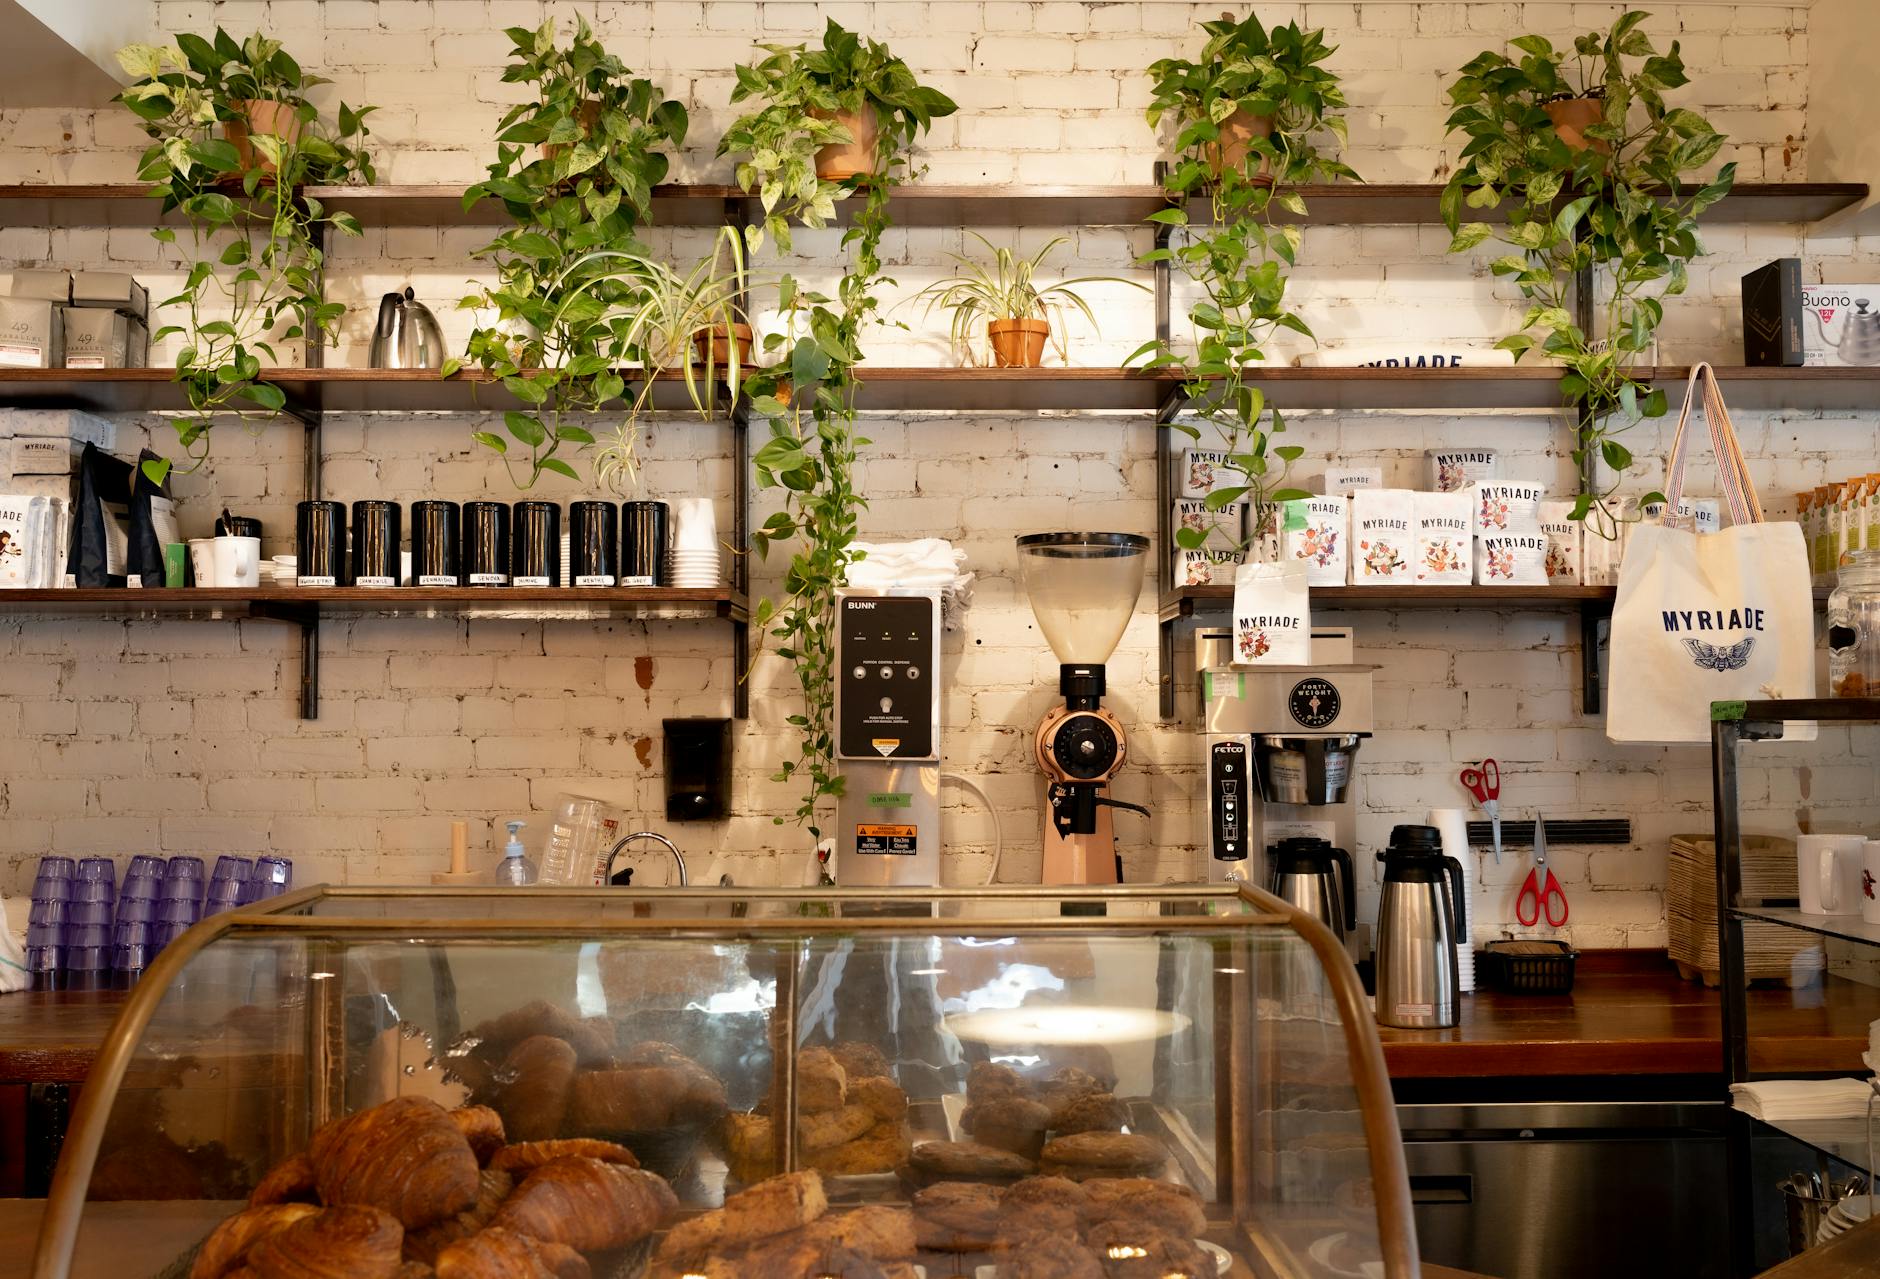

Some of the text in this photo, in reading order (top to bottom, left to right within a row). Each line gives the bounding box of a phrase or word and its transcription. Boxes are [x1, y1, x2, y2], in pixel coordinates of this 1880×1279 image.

[1801, 292, 1851, 306] Buono
[1437, 453, 1493, 465] MYRIADE
[1481, 487, 1540, 501] MYRIADE
[1363, 519, 1408, 531] MYRIADE
[1421, 518, 1467, 530] MYRIADE
[1540, 524, 1574, 534] YRIADE
[1485, 538, 1544, 551] MYRIADE
[1185, 551, 1241, 564] MYRIADE
[1240, 616, 1300, 629] MYRIADE
[1662, 607, 1764, 631] MYRIADE
